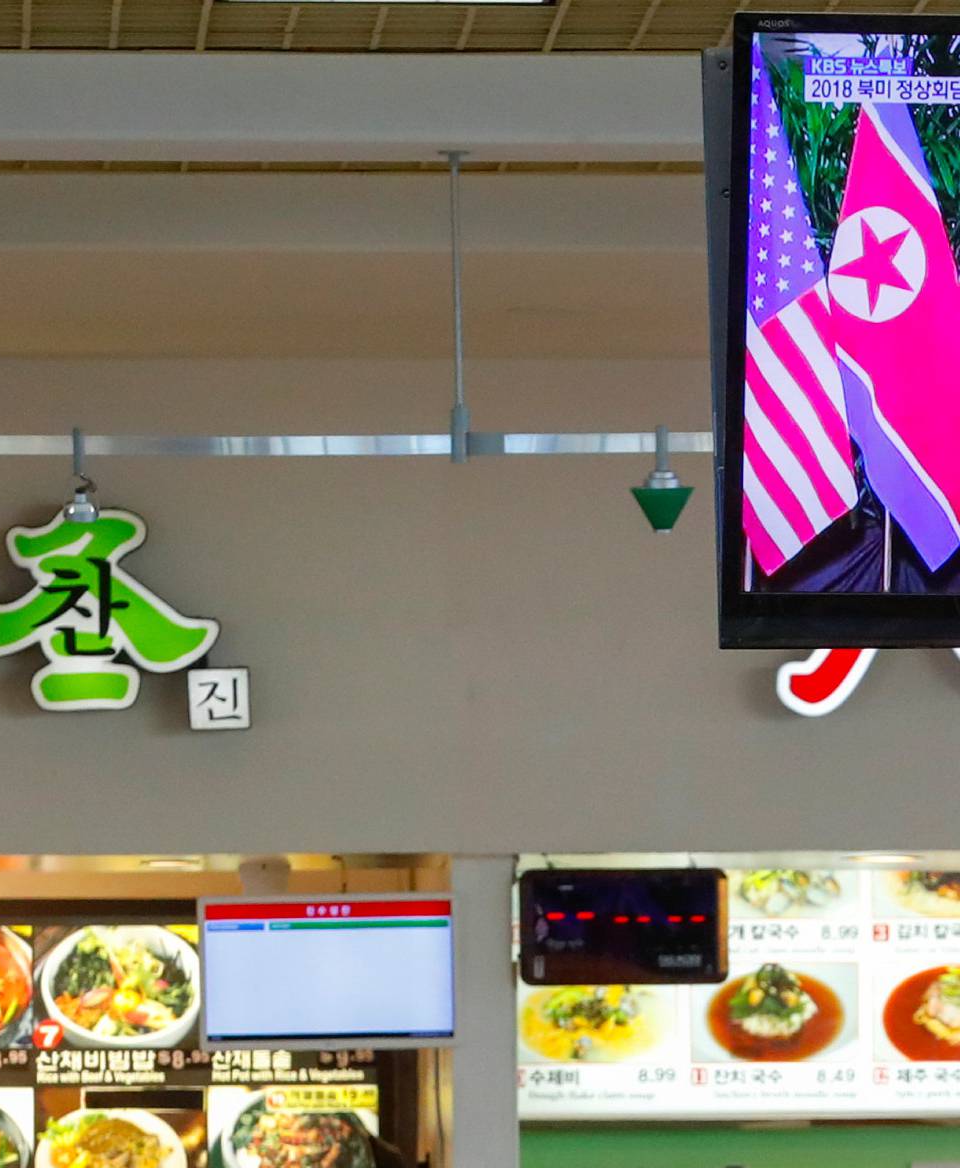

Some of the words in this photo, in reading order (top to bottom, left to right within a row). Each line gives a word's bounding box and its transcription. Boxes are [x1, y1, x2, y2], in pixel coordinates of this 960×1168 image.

[812, 60, 846, 74] KBS
[812, 79, 852, 98] 2018
[858, 79, 891, 99] 북미
[638, 1068, 676, 1083] 8.99
